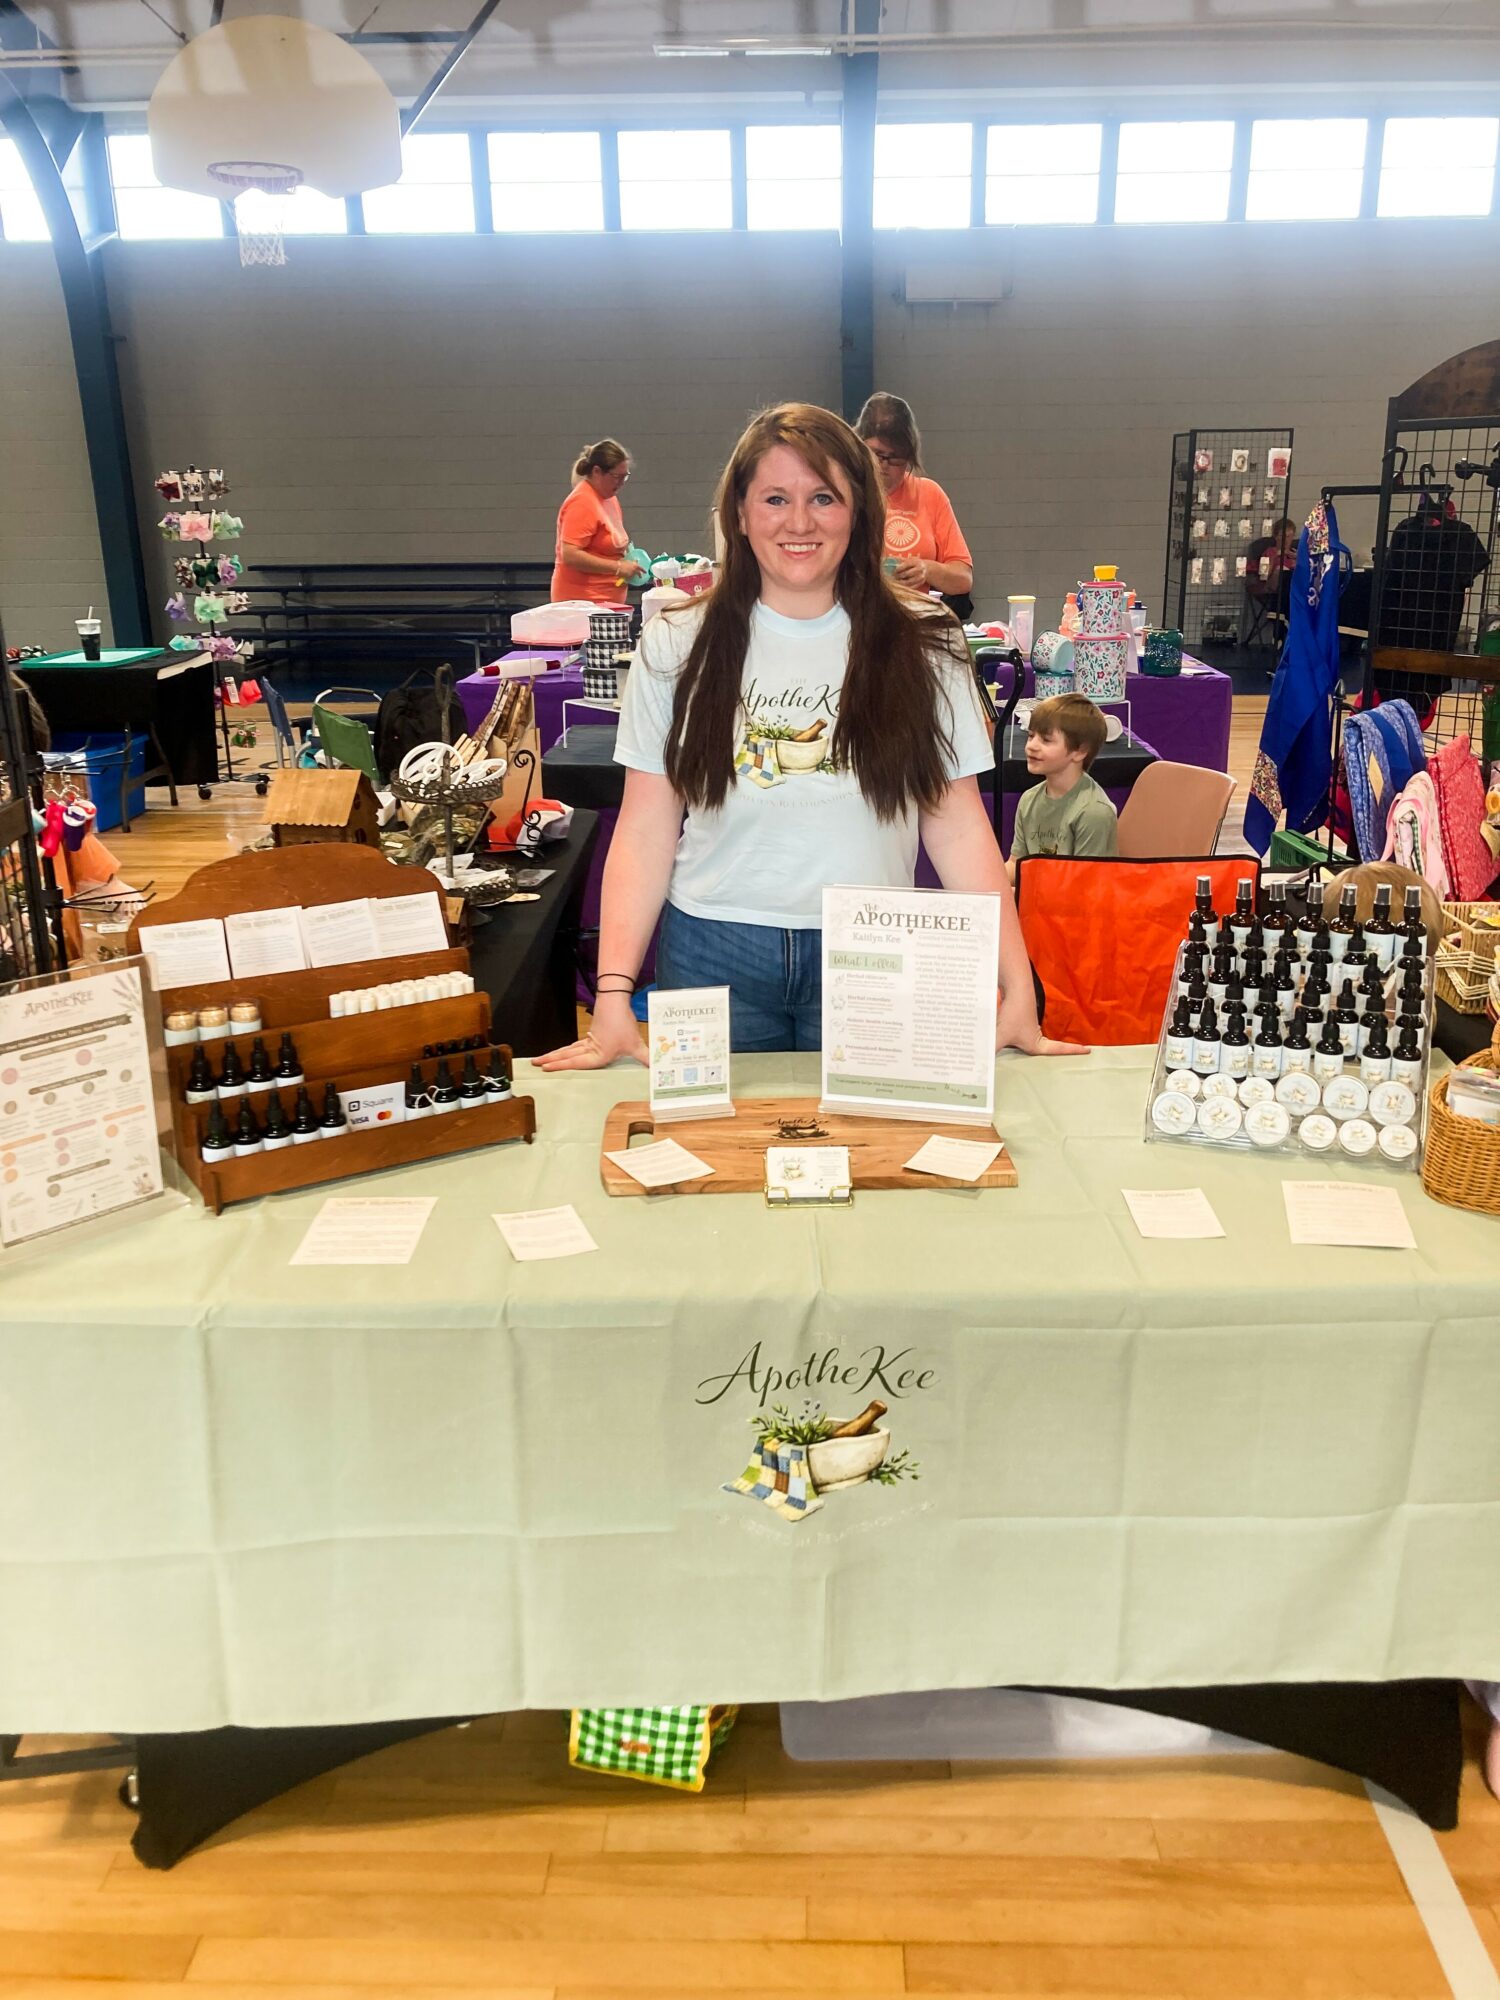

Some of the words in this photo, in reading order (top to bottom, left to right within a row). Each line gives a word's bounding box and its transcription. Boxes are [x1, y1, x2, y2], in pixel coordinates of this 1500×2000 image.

[853, 911, 971, 932] APOTHEKEE
[852, 931, 883, 944] Kaitlyn
[885, 934, 901, 944] Kee
[833, 954, 862, 967] What
[362, 1097, 393, 1108] Square
[351, 1116, 369, 1125] VISA
[695, 1341, 940, 1407] ApotheKee
